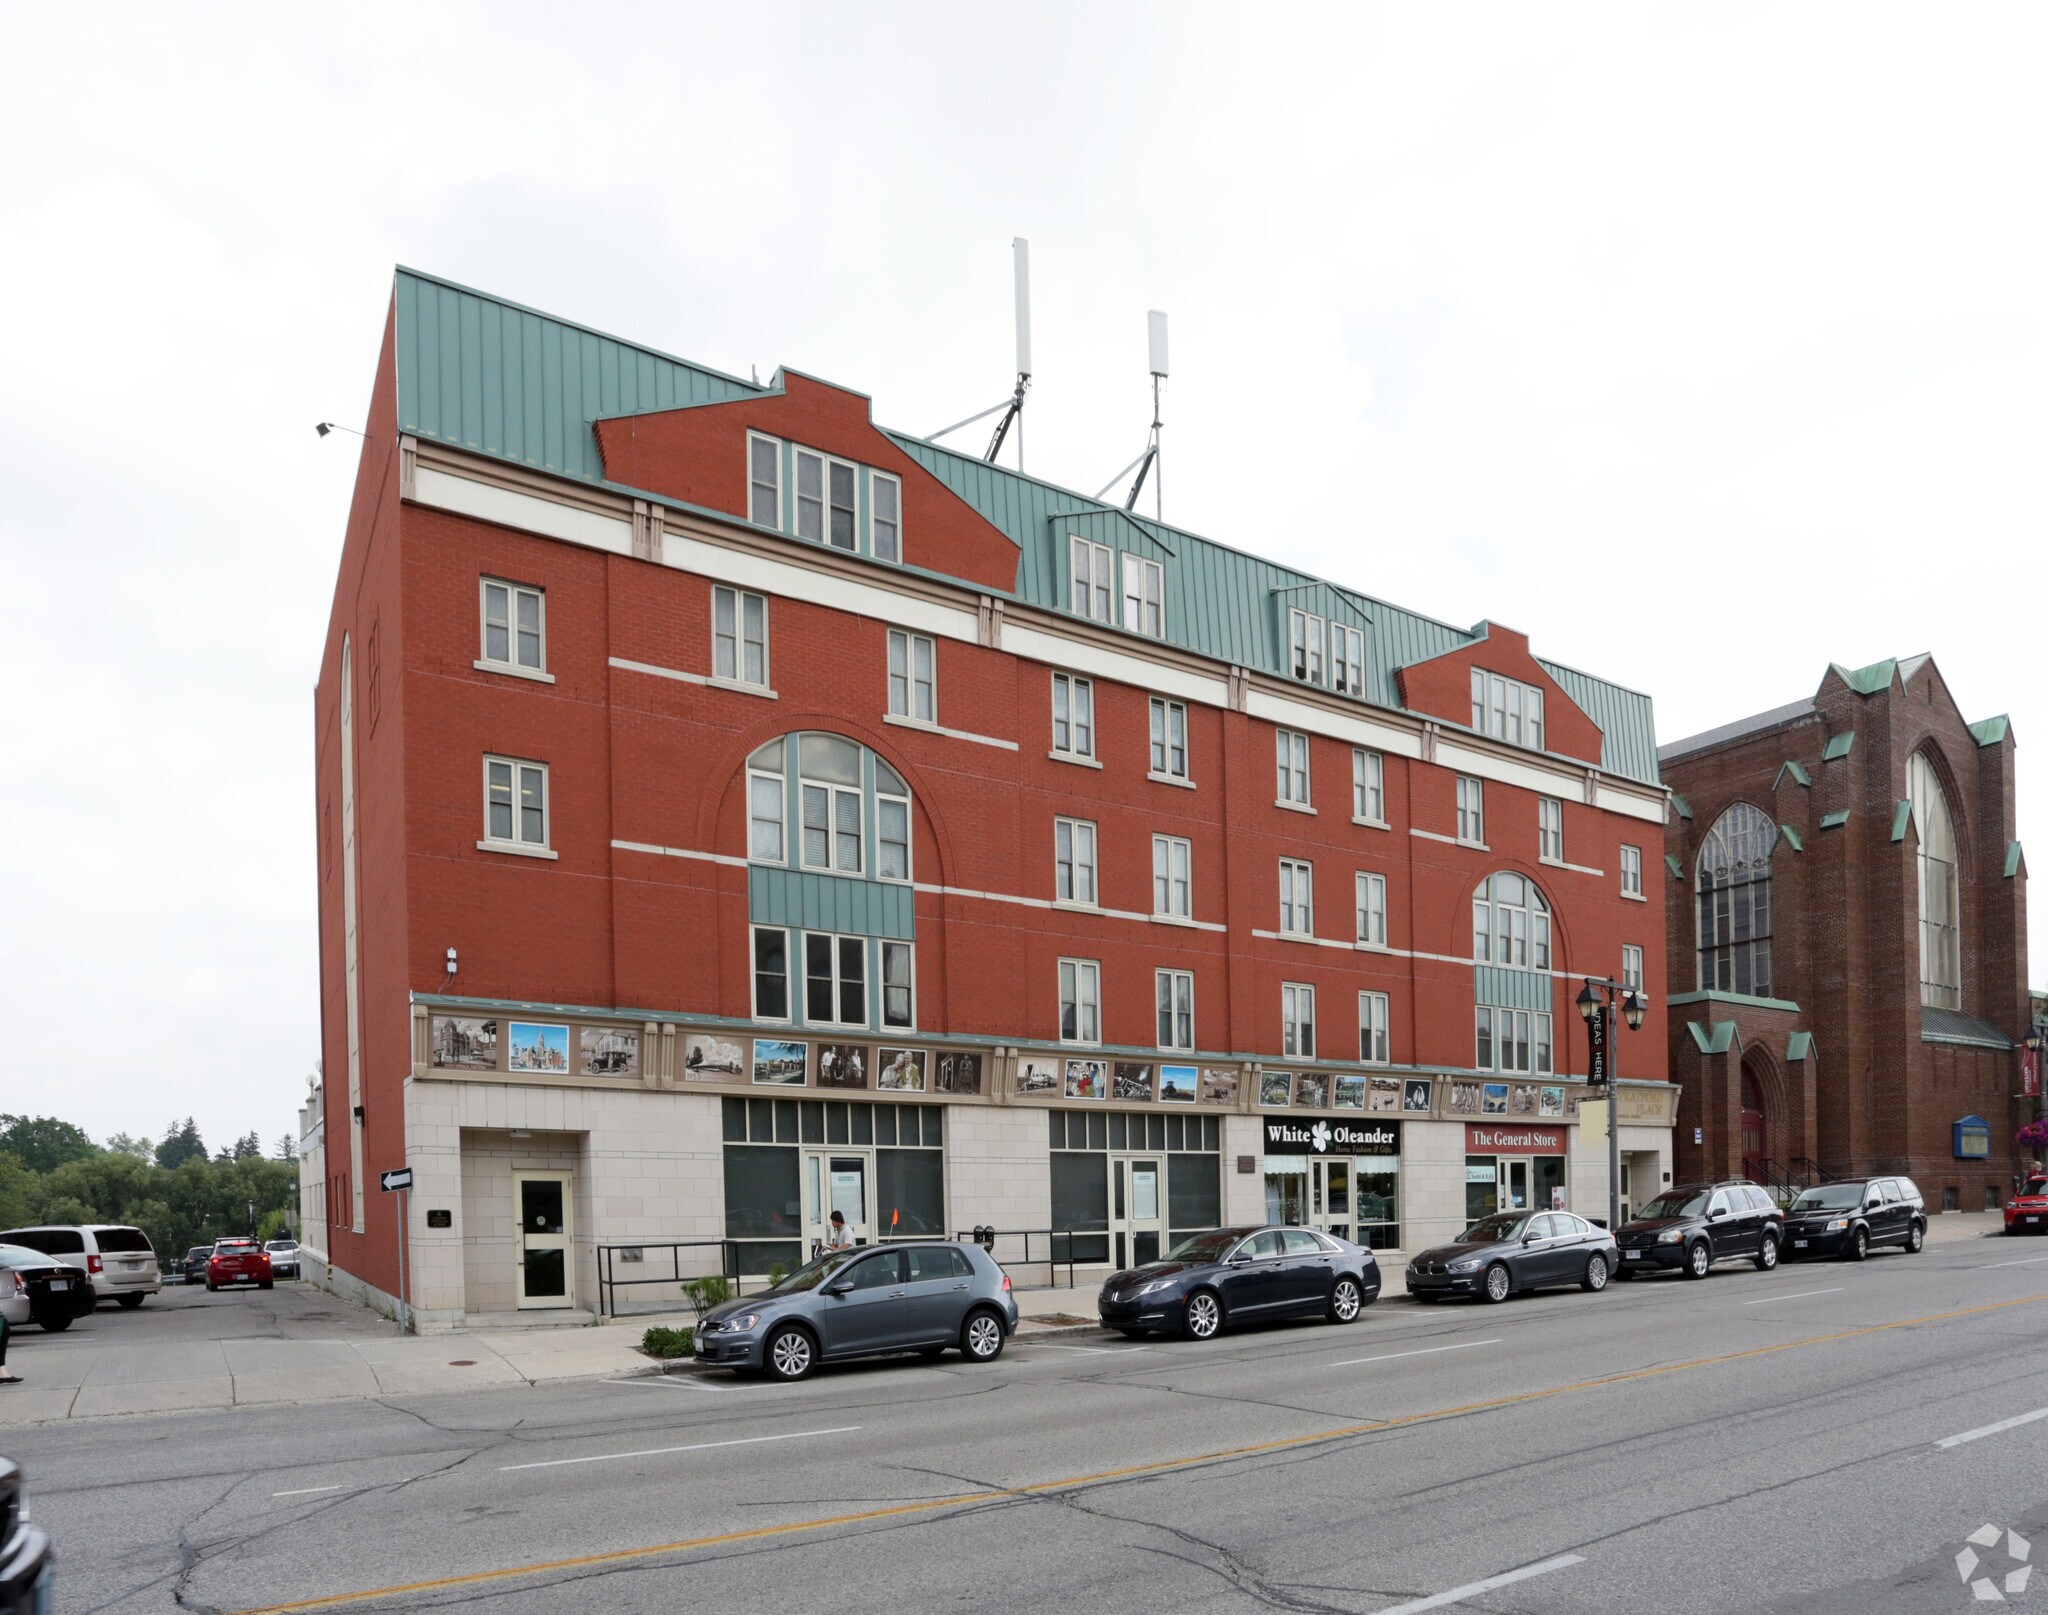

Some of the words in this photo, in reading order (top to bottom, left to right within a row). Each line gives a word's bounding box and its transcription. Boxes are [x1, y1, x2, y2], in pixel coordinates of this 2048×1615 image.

[1594, 1052, 1602, 1081] HERE
[1617, 1090, 1663, 1103] TRATFORD
[1636, 1103, 1663, 1115] PLACE
[1268, 1125, 1311, 1142] White
[1334, 1127, 1394, 1143] Oleander
[1473, 1131, 1491, 1146] The
[1494, 1131, 1531, 1146] General
[1534, 1132, 1557, 1147] Store
[1335, 1145, 1351, 1153] Home
[1352, 1145, 1372, 1153] Fashion
[1374, 1145, 1379, 1153] &
[1380, 1145, 1393, 1155] Gifts
